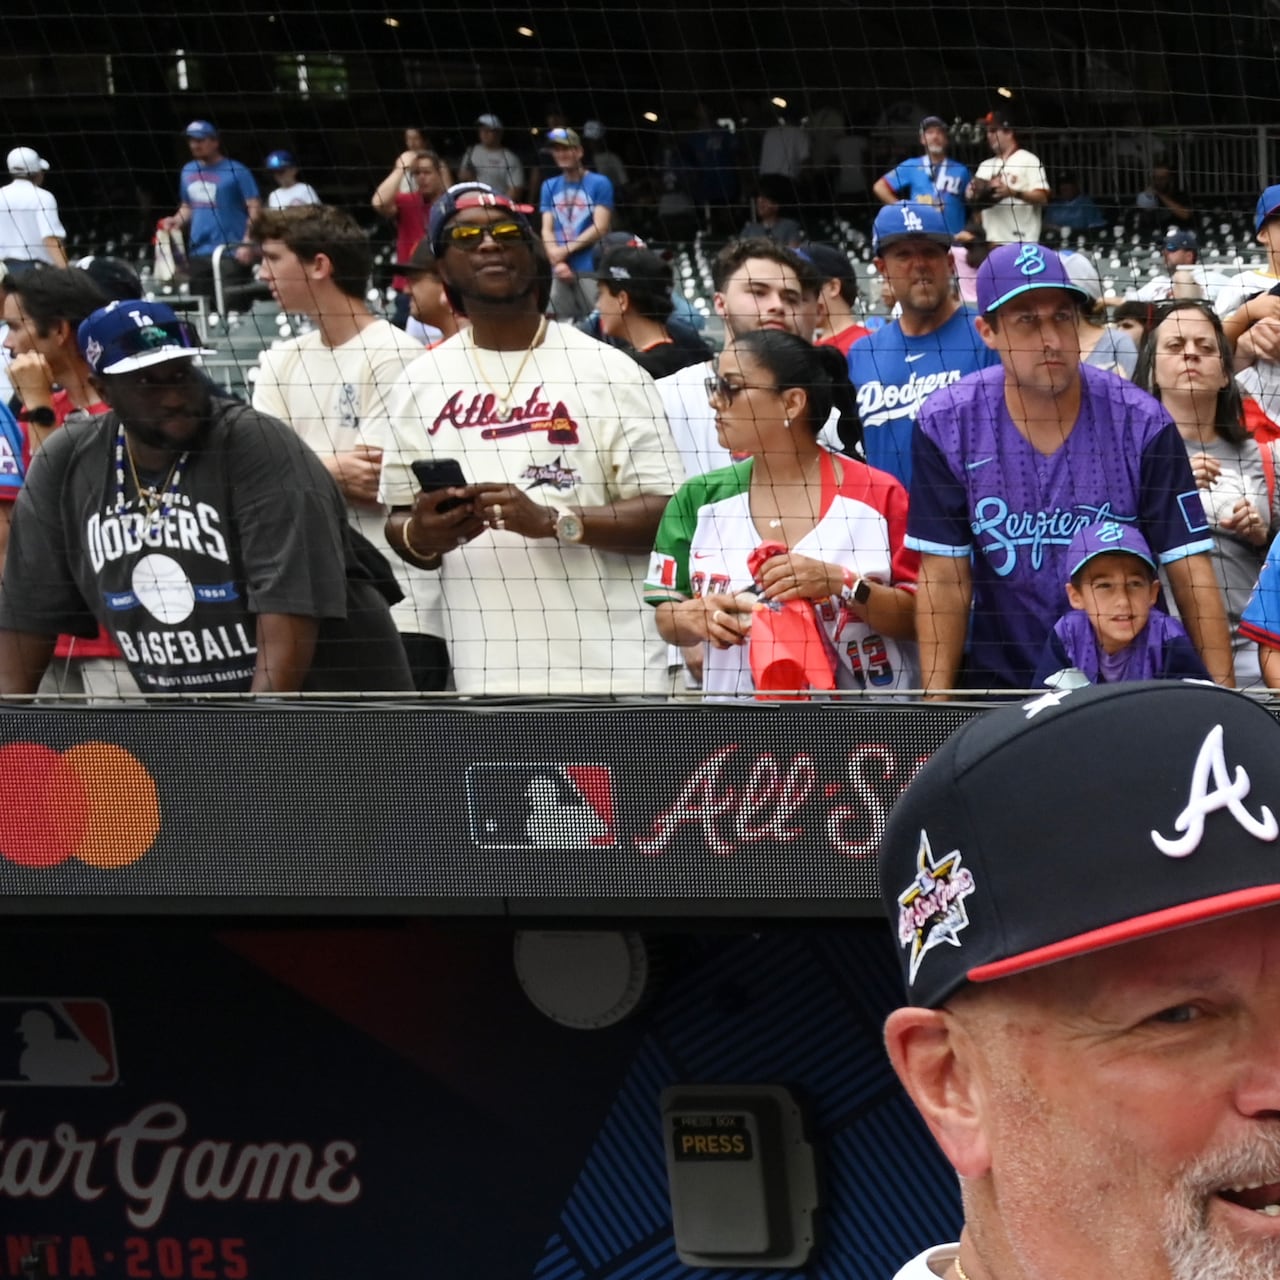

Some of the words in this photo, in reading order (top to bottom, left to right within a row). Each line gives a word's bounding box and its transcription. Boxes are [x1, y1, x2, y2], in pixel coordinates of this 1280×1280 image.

[88, 502, 230, 575] DODGERS
[116, 623, 258, 666] BASEBALL
[846, 633, 895, 688] 13
[634, 743, 816, 855] All
[1151, 724, 1280, 858] A
[0, 1108, 105, 1200] ar
[105, 1102, 361, 1229] Game
[681, 1135, 745, 1154] PRESS
[125, 1238, 249, 1280] 2025
